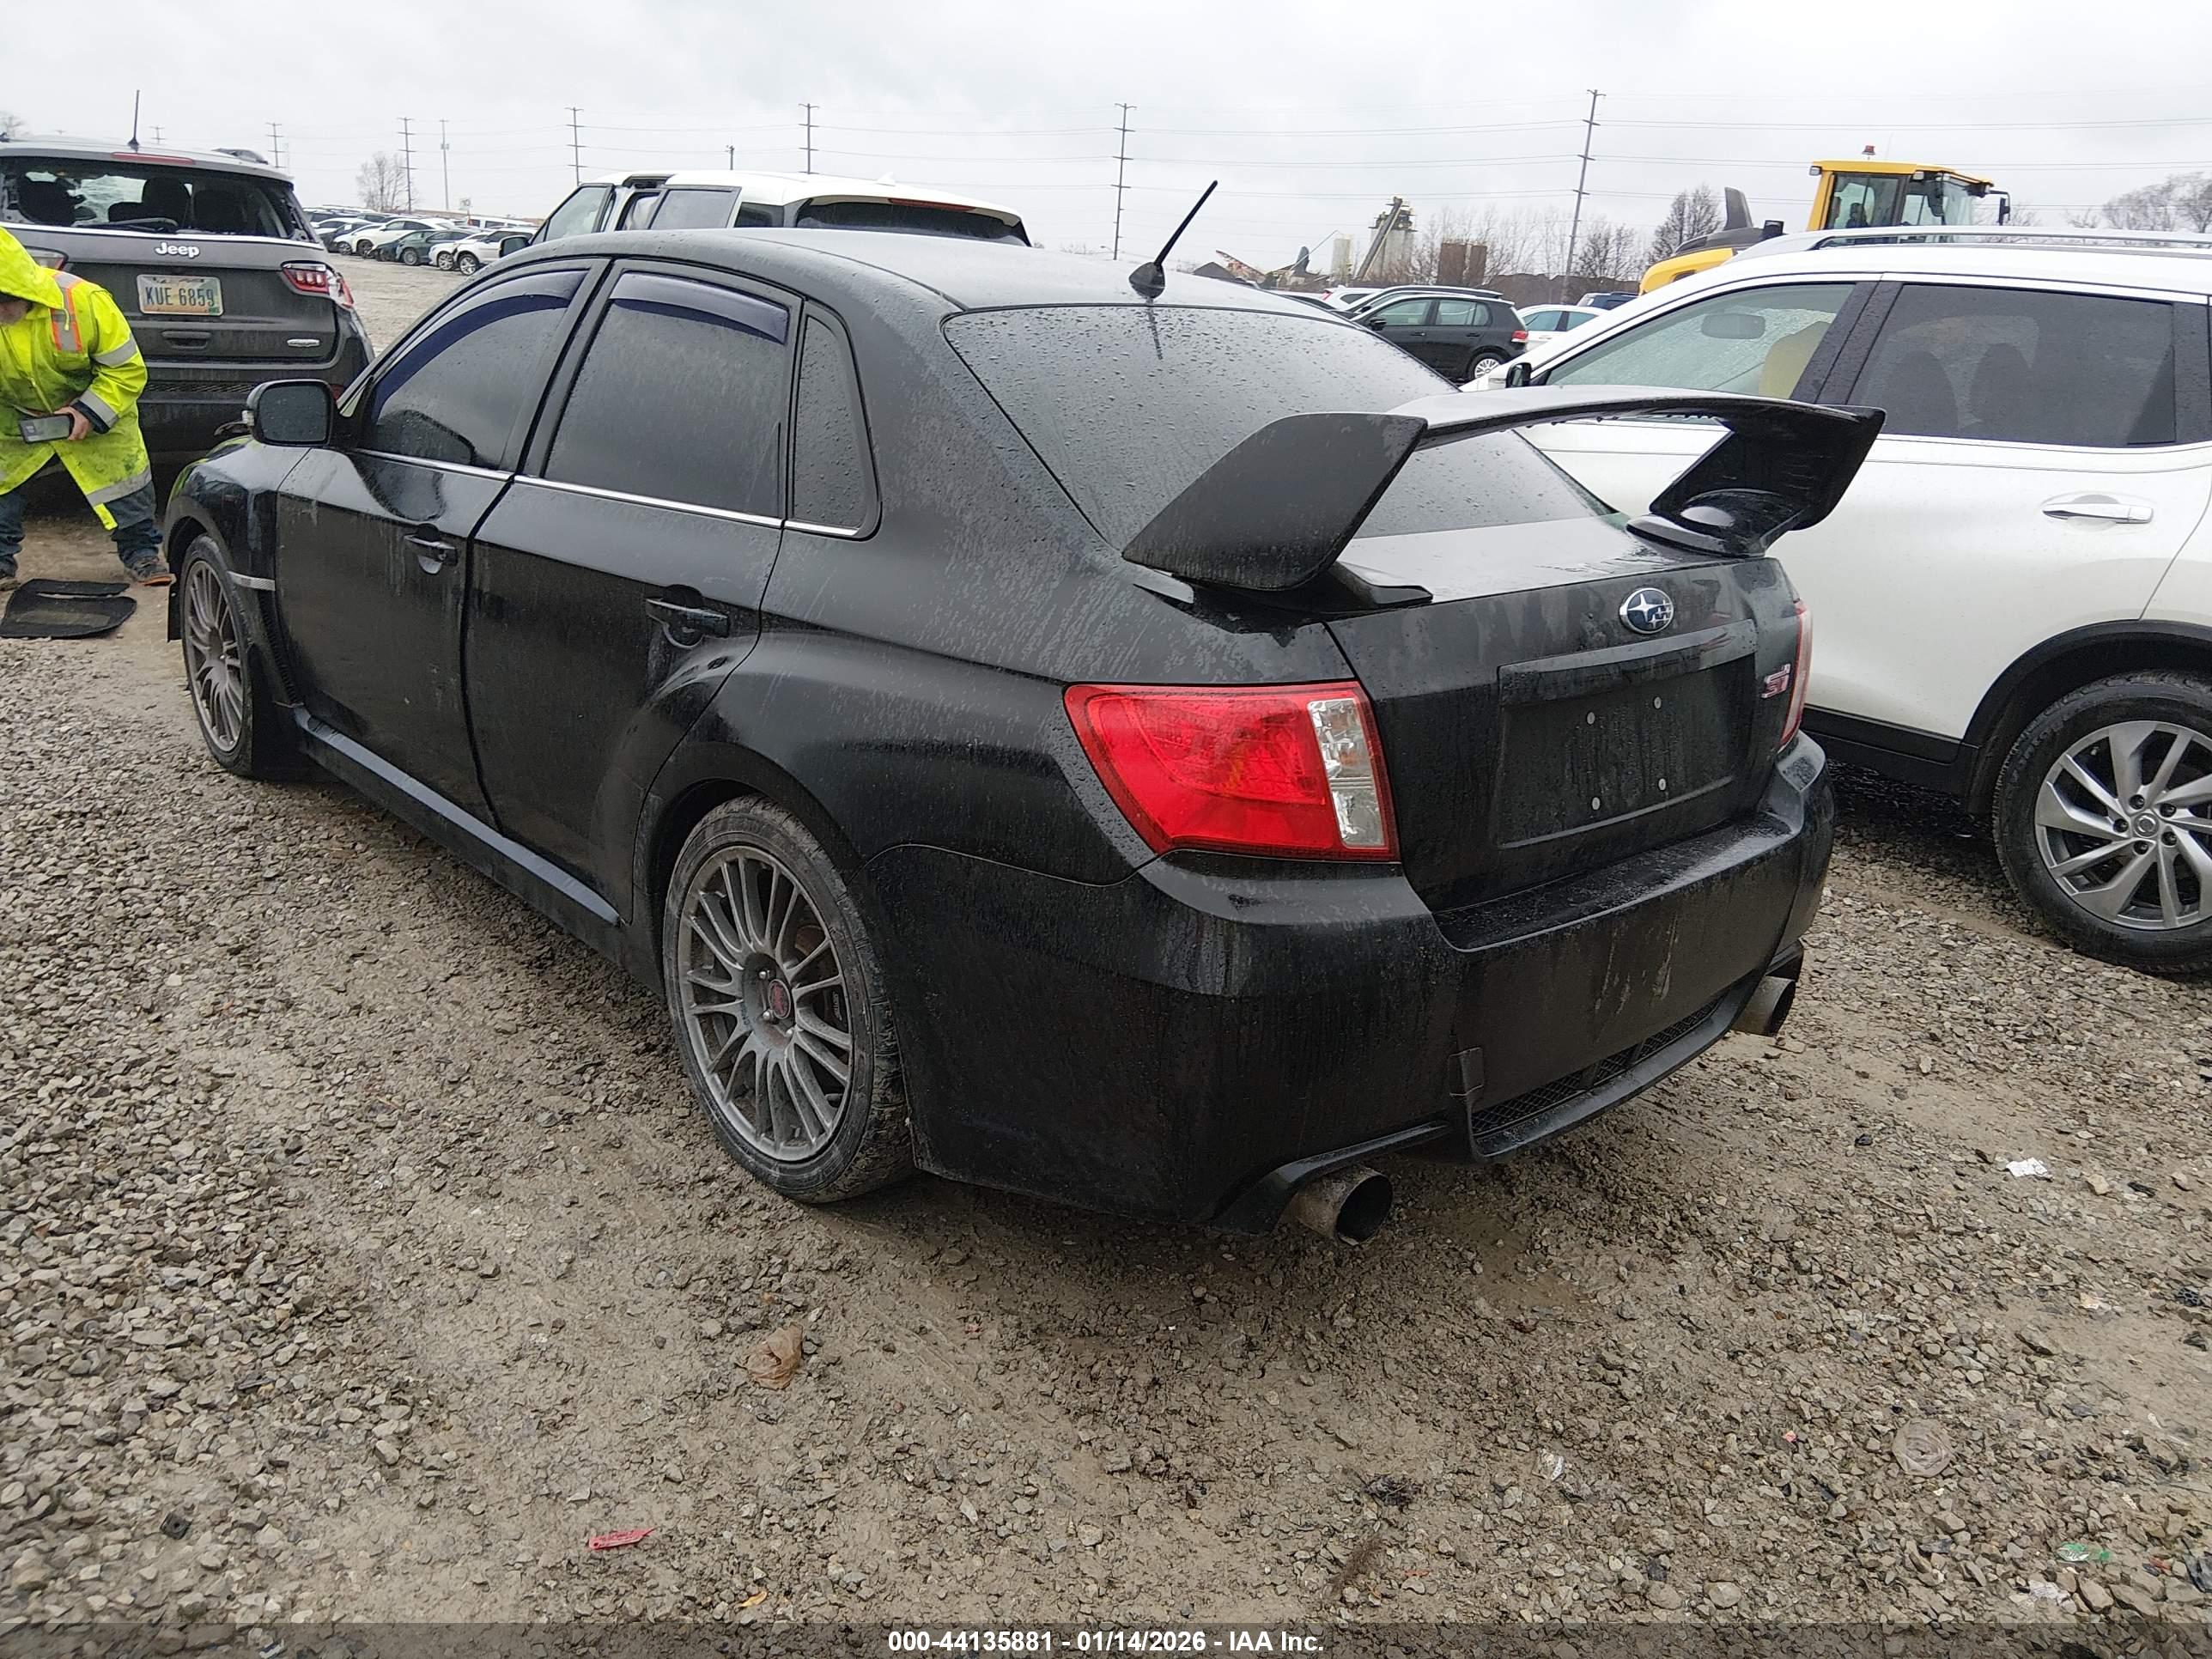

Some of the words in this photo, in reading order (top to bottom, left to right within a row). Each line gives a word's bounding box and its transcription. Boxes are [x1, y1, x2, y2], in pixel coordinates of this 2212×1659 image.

[155, 241, 200, 258] Jeep
[145, 286, 173, 306] KUE
[179, 288, 215, 307] 6859
